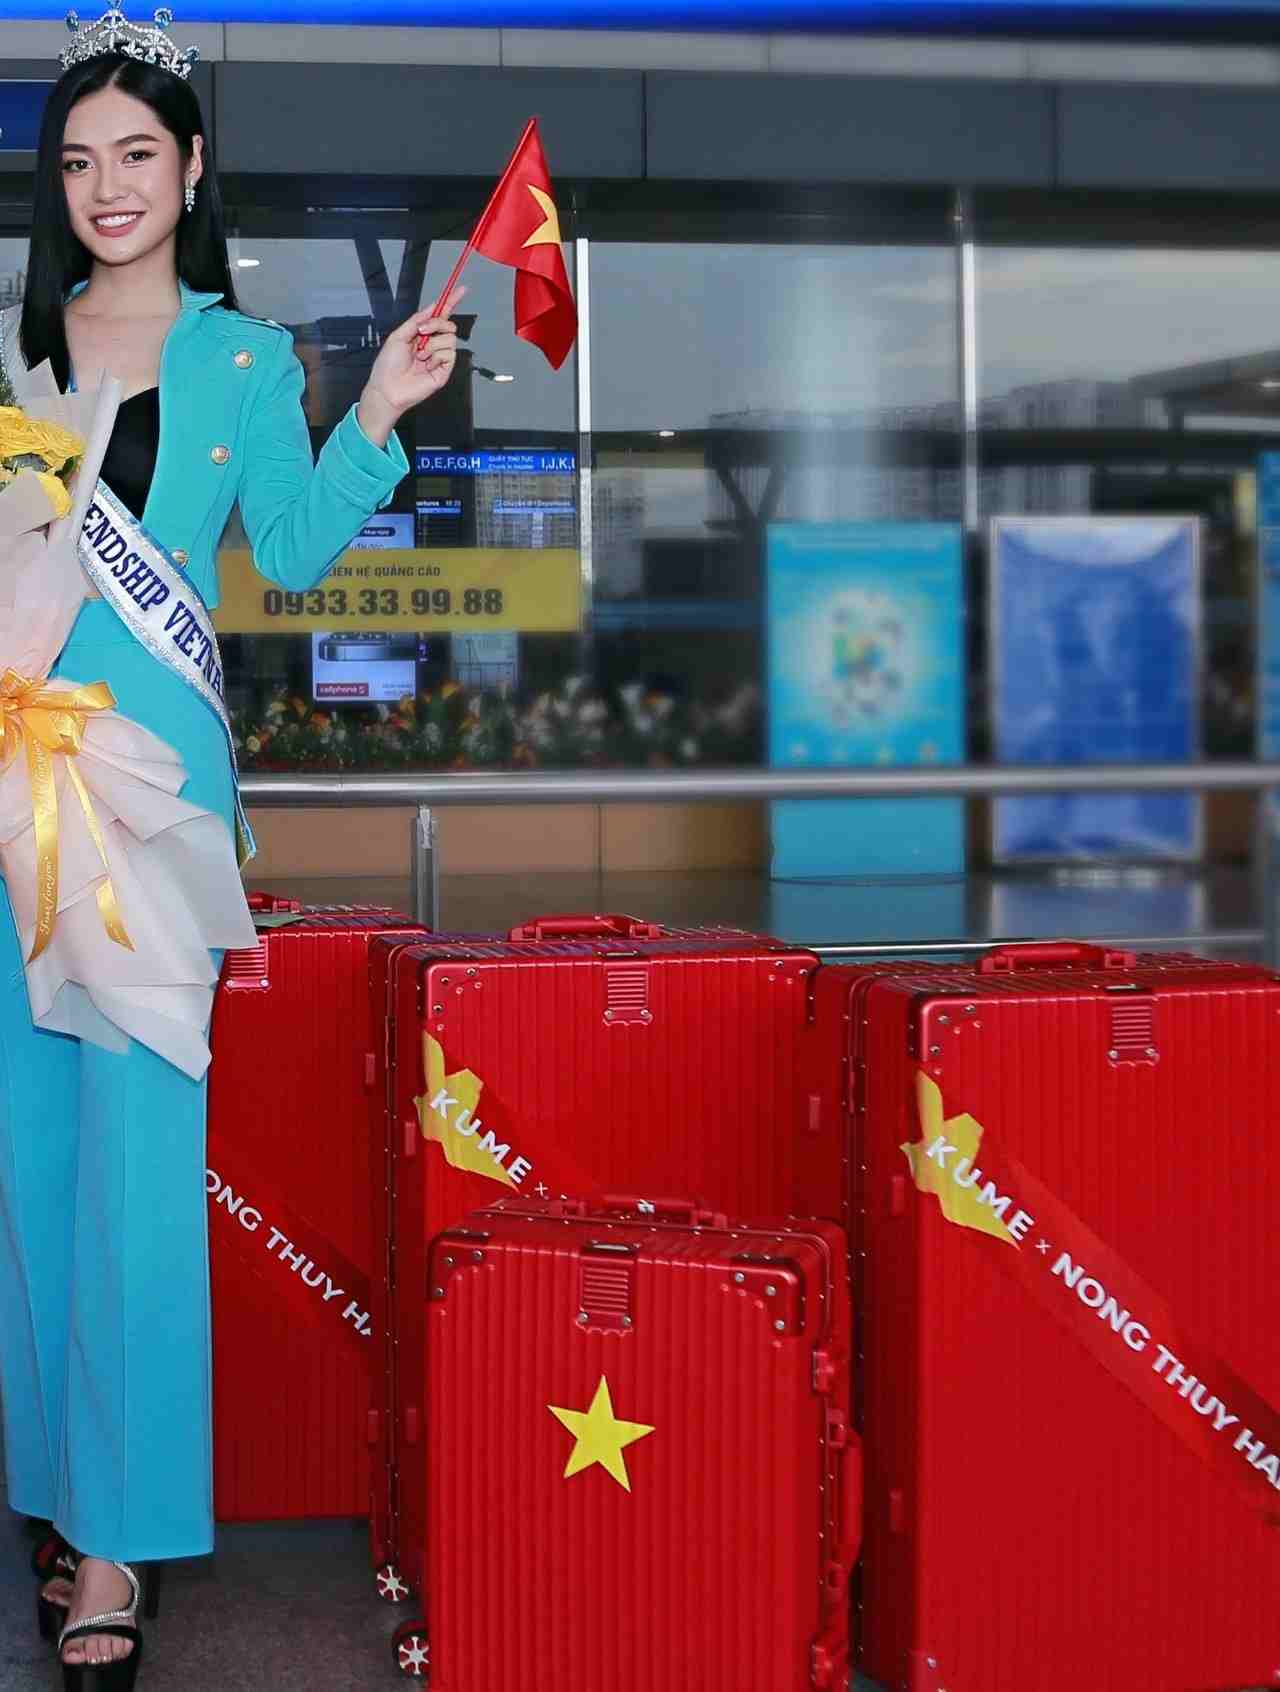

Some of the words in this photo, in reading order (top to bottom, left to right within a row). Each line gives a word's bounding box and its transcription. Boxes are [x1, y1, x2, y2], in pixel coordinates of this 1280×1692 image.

[263, 588, 504, 616] 0933.33.99.88
[430, 1088, 532, 1184] KUME
[266, 1226, 345, 1301] THUY
[926, 1135, 1034, 1240] KUME
[1051, 1252, 1151, 1352] NONG
[1152, 1344, 1239, 1431] THUY
[1233, 1429, 1280, 1490] HA
